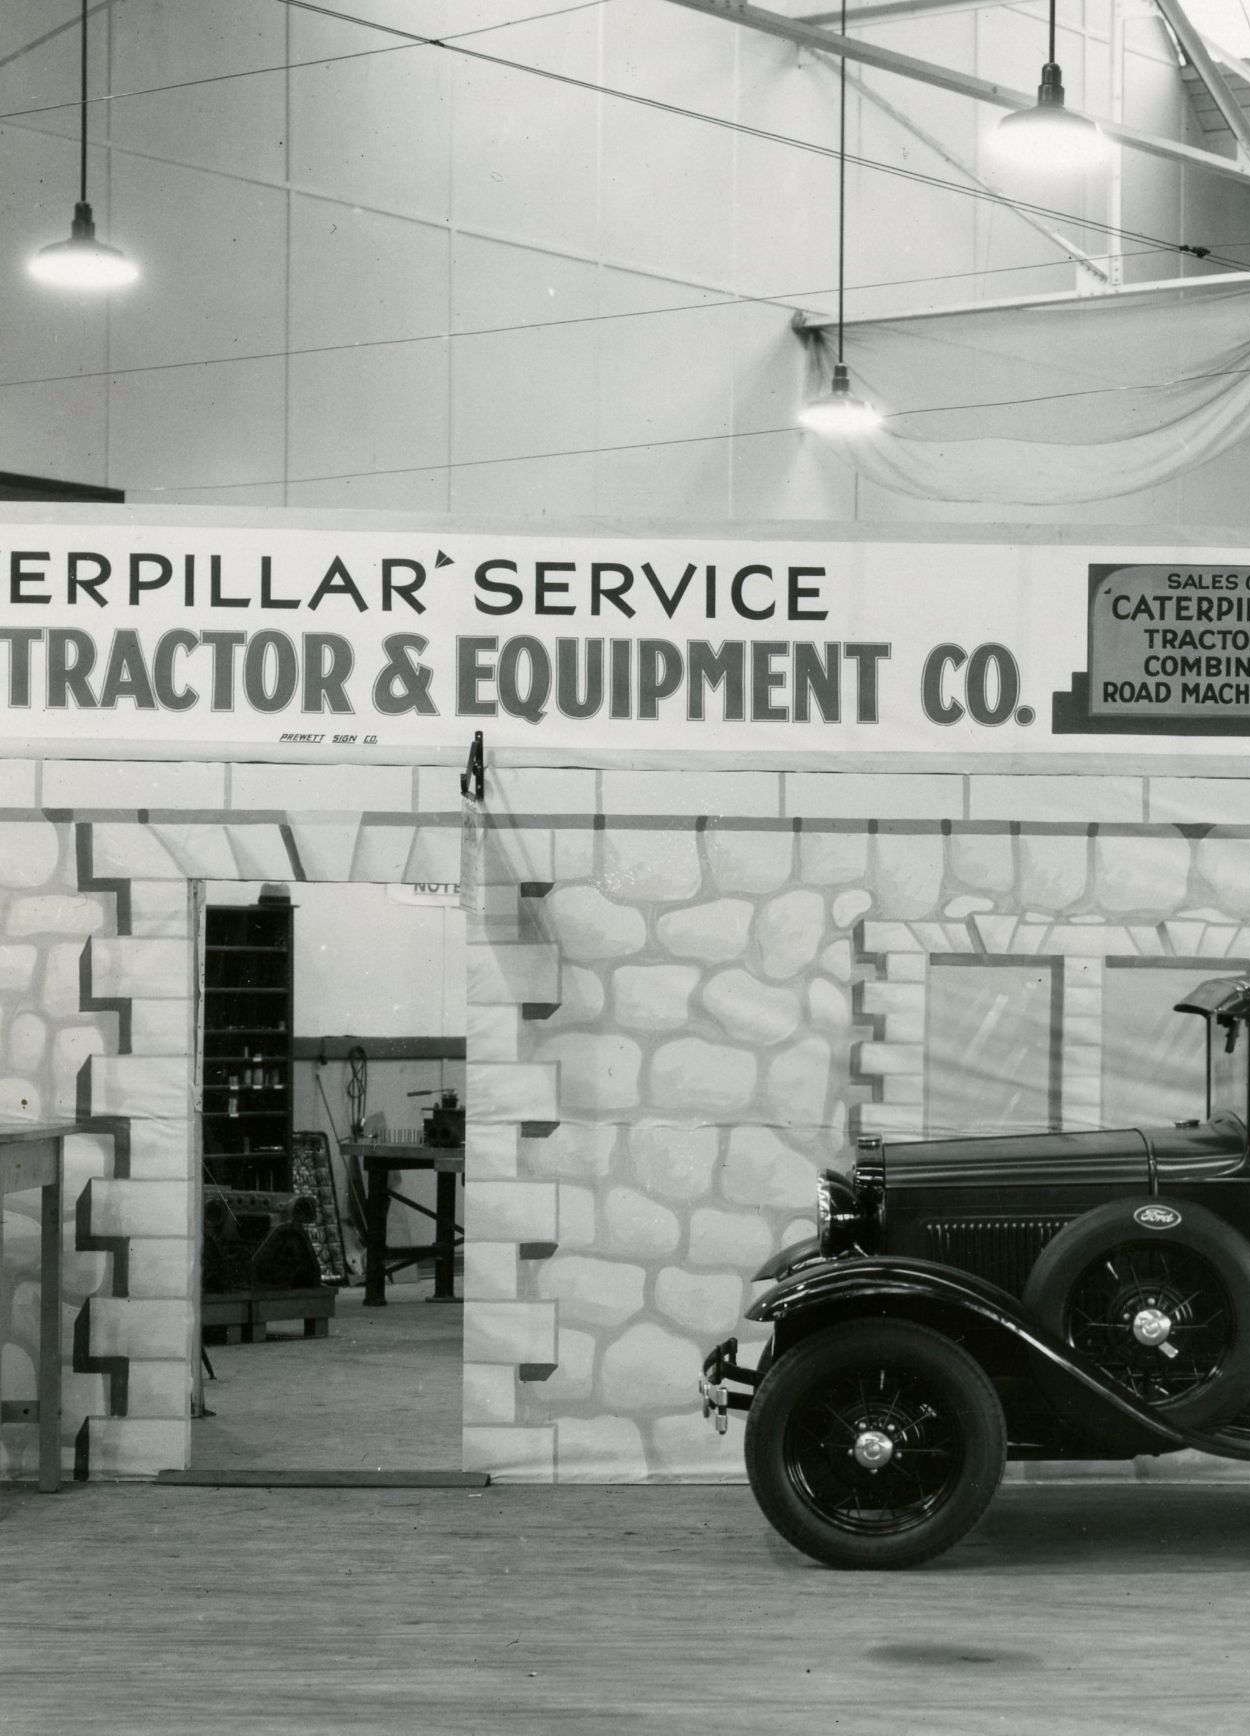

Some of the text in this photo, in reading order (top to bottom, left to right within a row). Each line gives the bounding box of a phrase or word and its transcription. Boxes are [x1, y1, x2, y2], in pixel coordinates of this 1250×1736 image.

[474, 558, 829, 621] SERVICE
[1167, 573, 1239, 590] SALES
[0, 626, 1036, 727] TRACTOR & EQUIPMENT CO.
[1103, 681, 1172, 704] ROAD
[332, 735, 357, 744] SIGN
[1140, 1209, 1174, 1223] Ford
